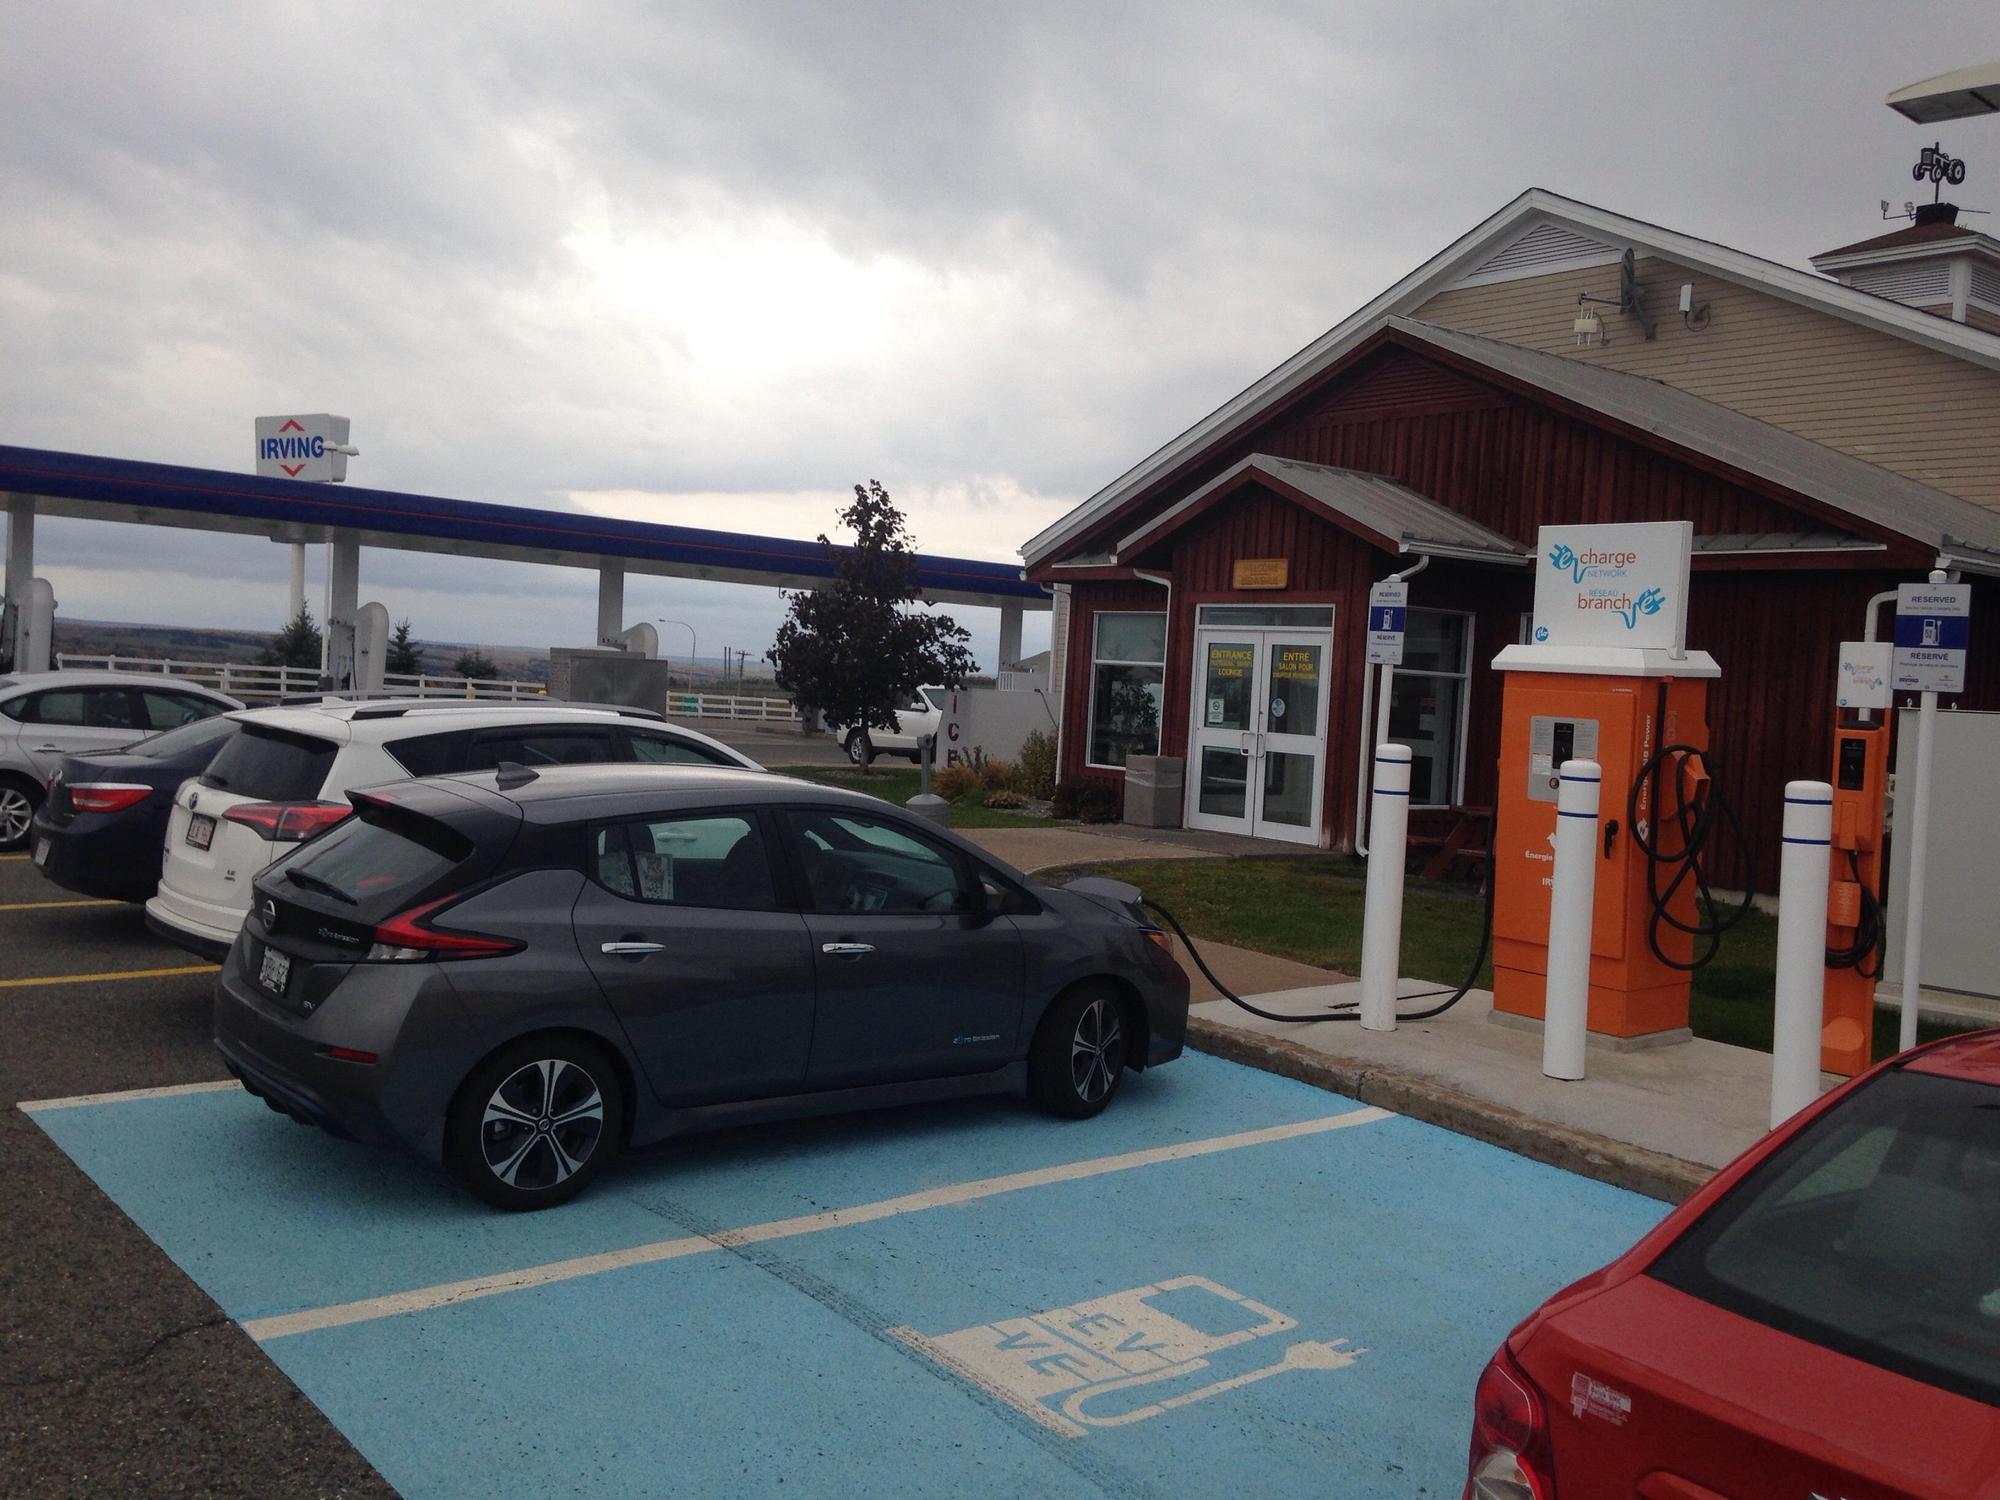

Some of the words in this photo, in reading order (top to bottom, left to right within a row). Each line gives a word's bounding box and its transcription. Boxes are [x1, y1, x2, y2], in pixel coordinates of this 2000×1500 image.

[261, 435, 324, 459] IRVING
[1587, 569, 1627, 578] NETWORK
[1068, 1313, 1169, 1352] EV
[995, 1330, 1090, 1378] VE
